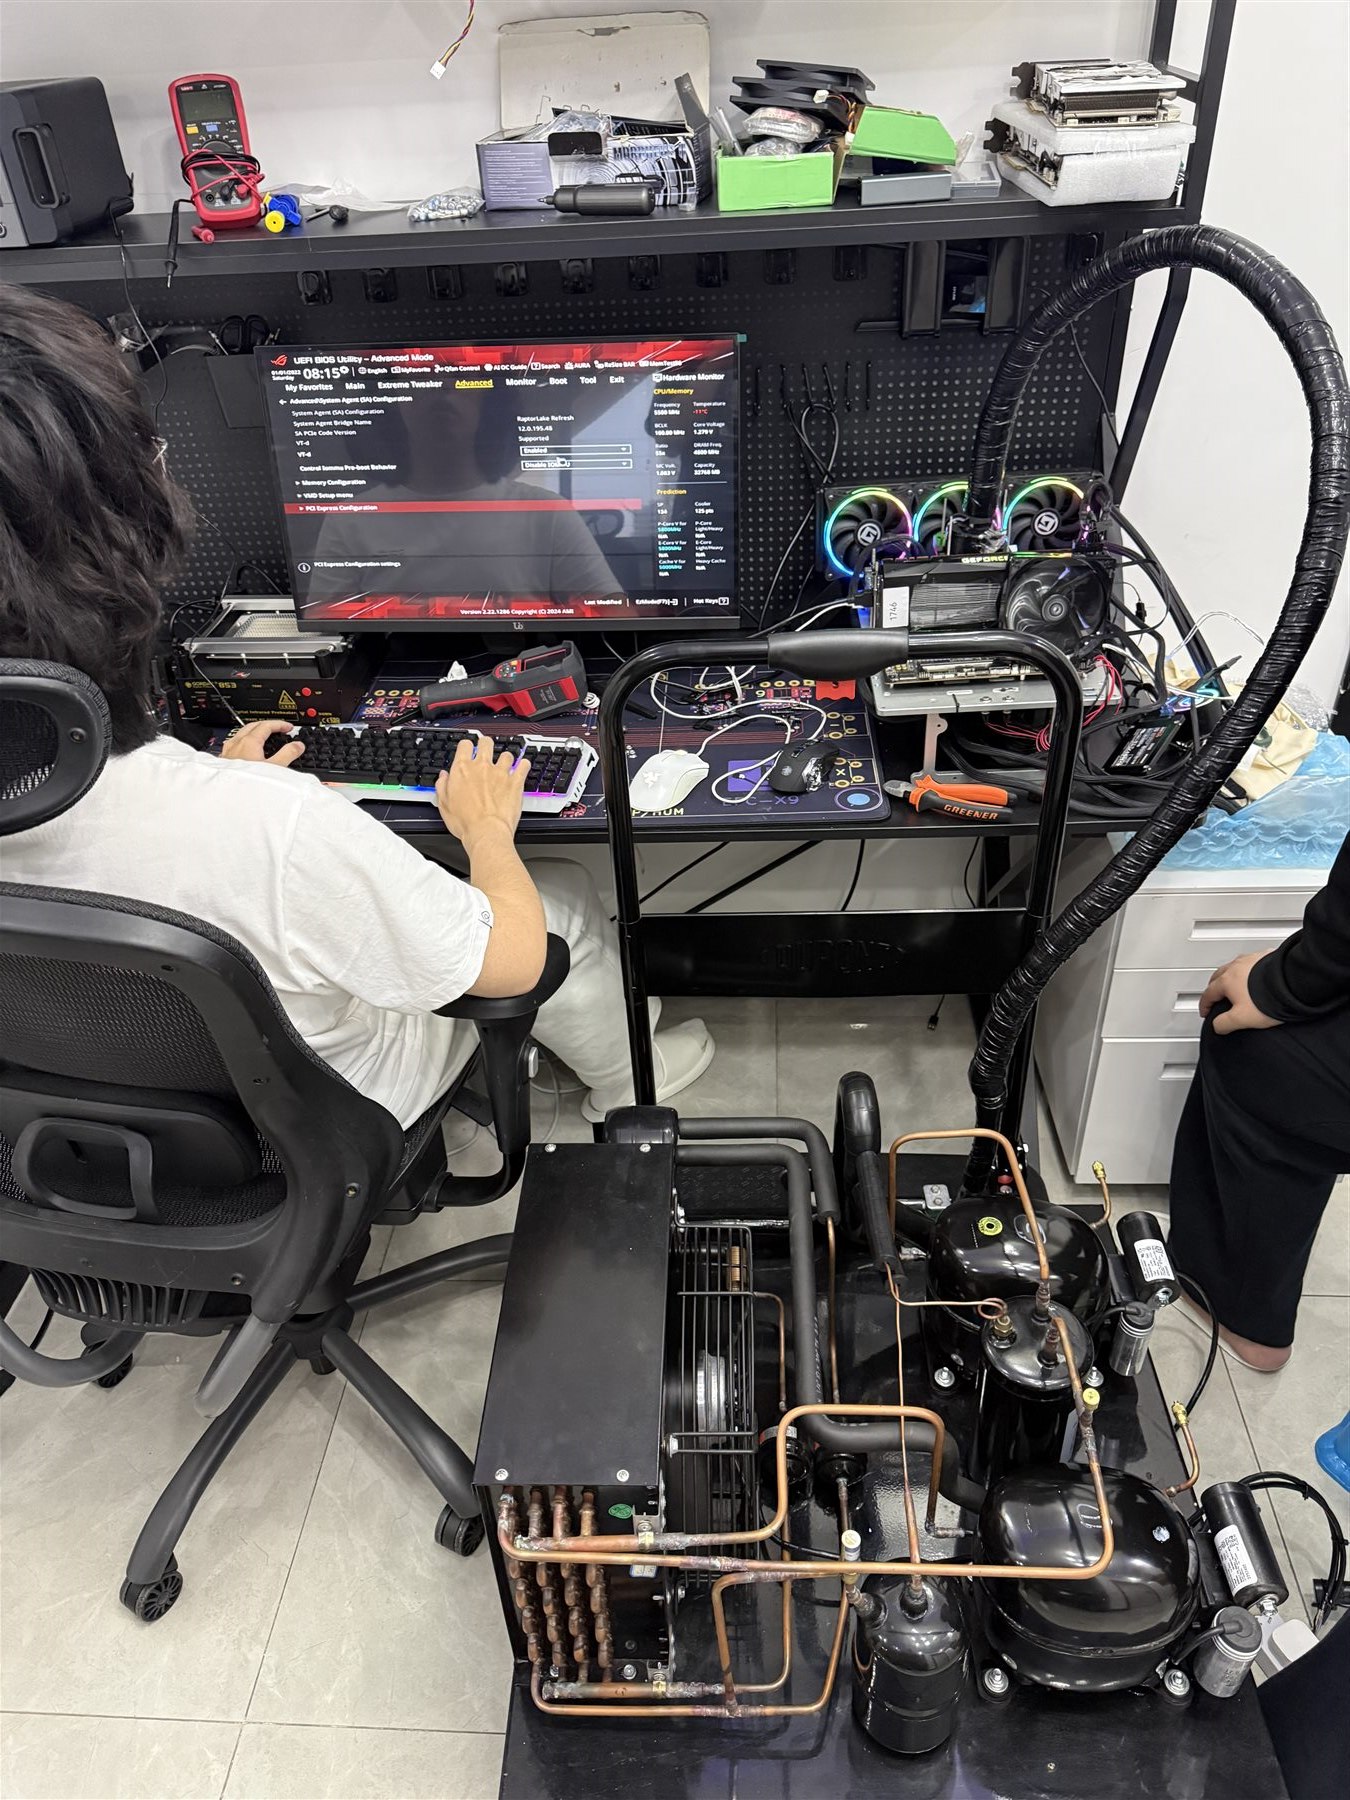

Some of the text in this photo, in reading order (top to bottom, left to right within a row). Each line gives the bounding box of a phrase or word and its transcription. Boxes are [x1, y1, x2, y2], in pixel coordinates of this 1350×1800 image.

[293, 353, 434, 365] UEFI BIOS Utility Advanced Mode
[303, 367, 340, 380] 08:15
[662, 373, 697, 381] Hardware
[285, 384, 298, 393] My
[299, 383, 334, 391] Favorites
[345, 382, 366, 390] Main
[377, 381, 410, 389] Extreme
[455, 378, 494, 387] Advanced
[505, 378, 537, 386] Monitor
[549, 377, 568, 385] Boot
[579, 376, 597, 384] Tool
[609, 376, 625, 384] Exit
[653, 388, 694, 396] CPU/Memory
[518, 435, 550, 443] Supported
[327, 479, 367, 487] Configuration
[943, 804, 998, 820] GREENER
